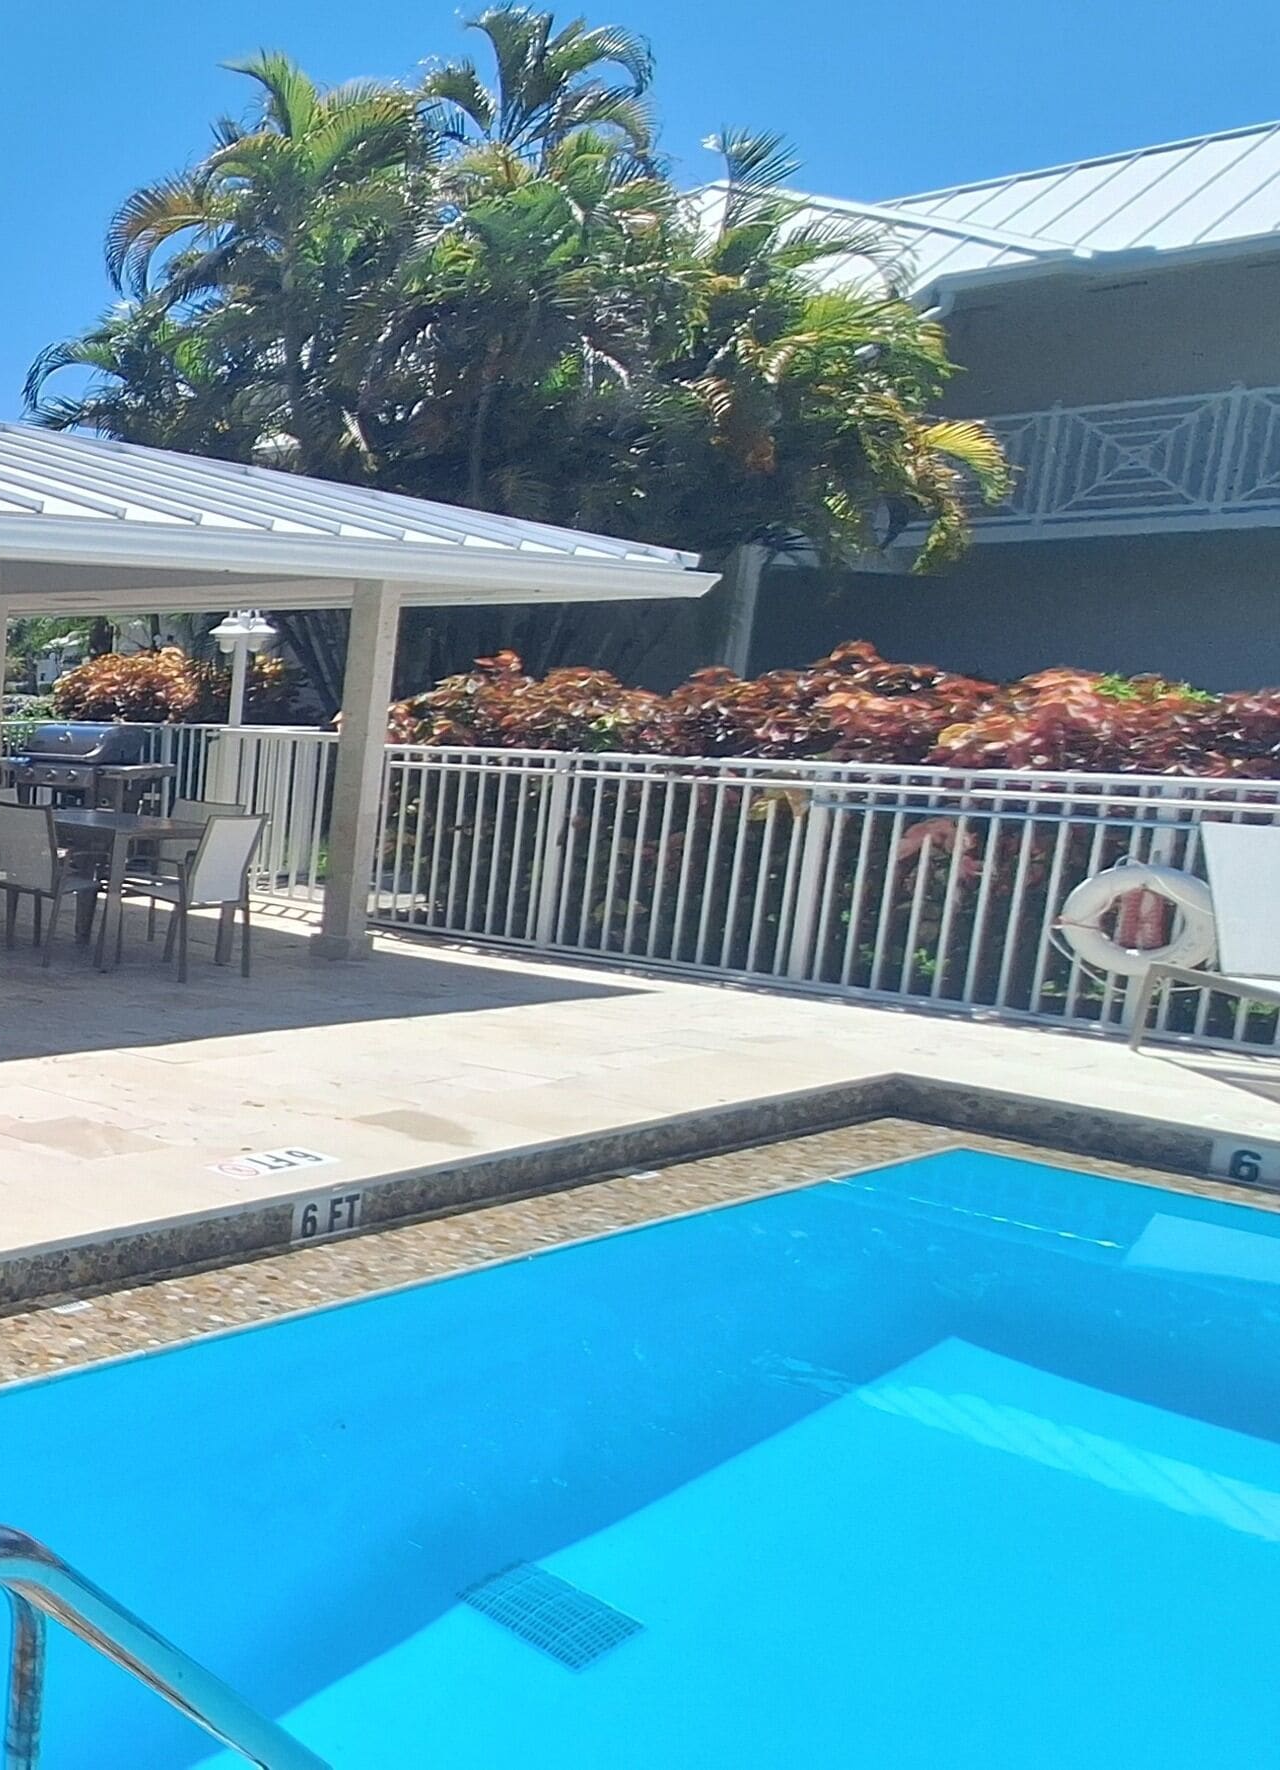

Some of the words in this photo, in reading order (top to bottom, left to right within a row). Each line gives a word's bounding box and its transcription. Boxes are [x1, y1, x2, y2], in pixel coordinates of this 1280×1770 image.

[245, 1154, 299, 1169] FT
[1229, 1149, 1262, 1182] 6
[301, 1203, 317, 1238] 6
[328, 1193, 361, 1233] FT
